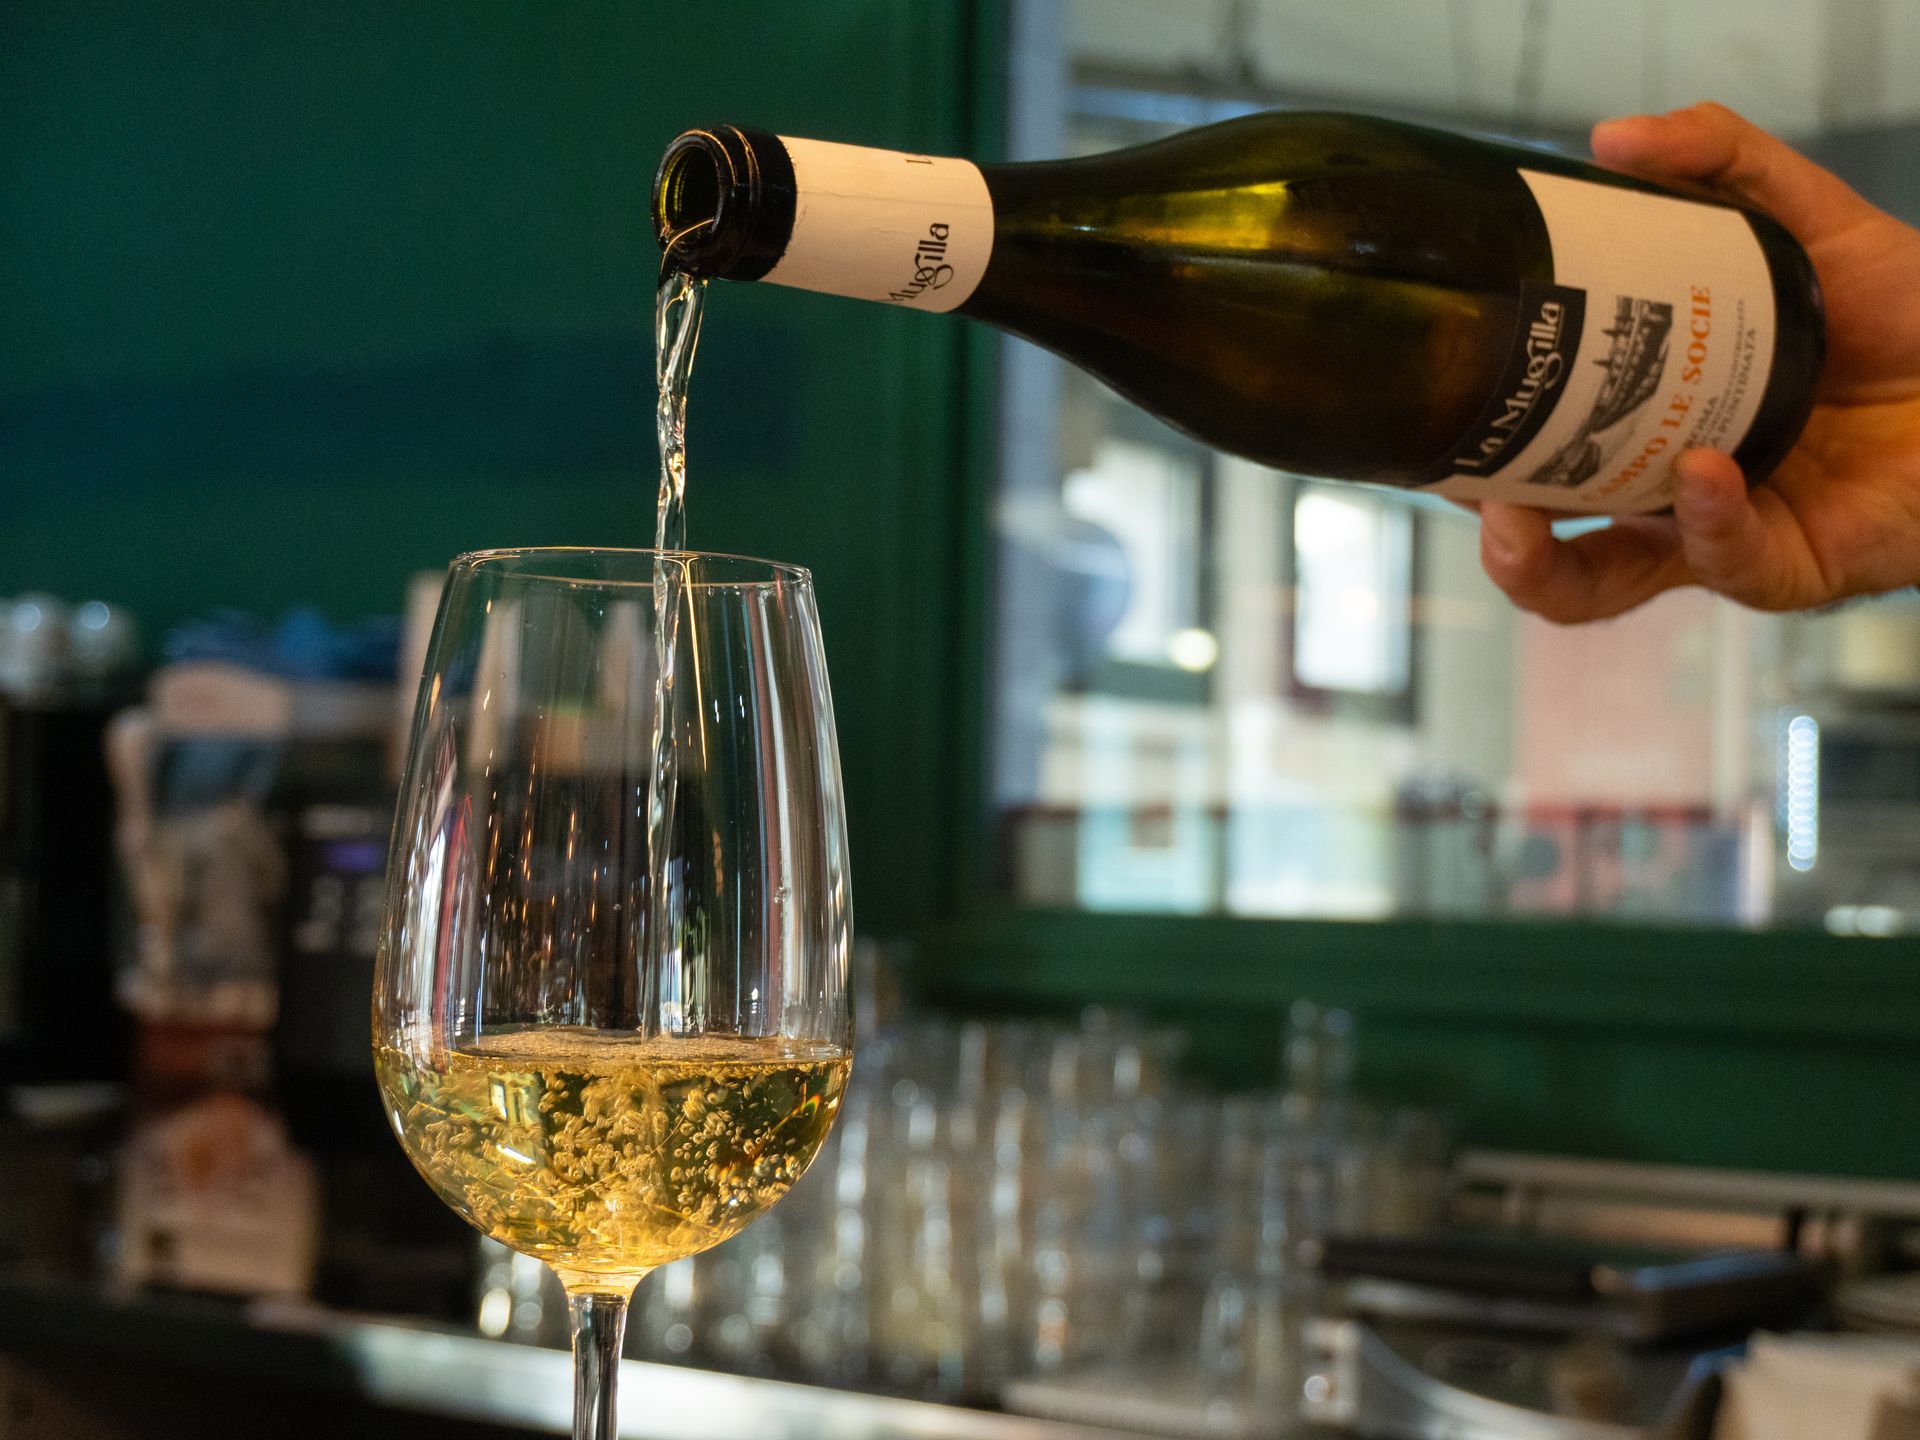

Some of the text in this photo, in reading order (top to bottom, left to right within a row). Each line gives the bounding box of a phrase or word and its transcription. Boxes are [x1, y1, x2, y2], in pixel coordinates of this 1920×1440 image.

[1454, 301, 1565, 468] La Mugilla
[1659, 393, 1693, 428] LE
[1682, 285, 1711, 386] SOCIE
